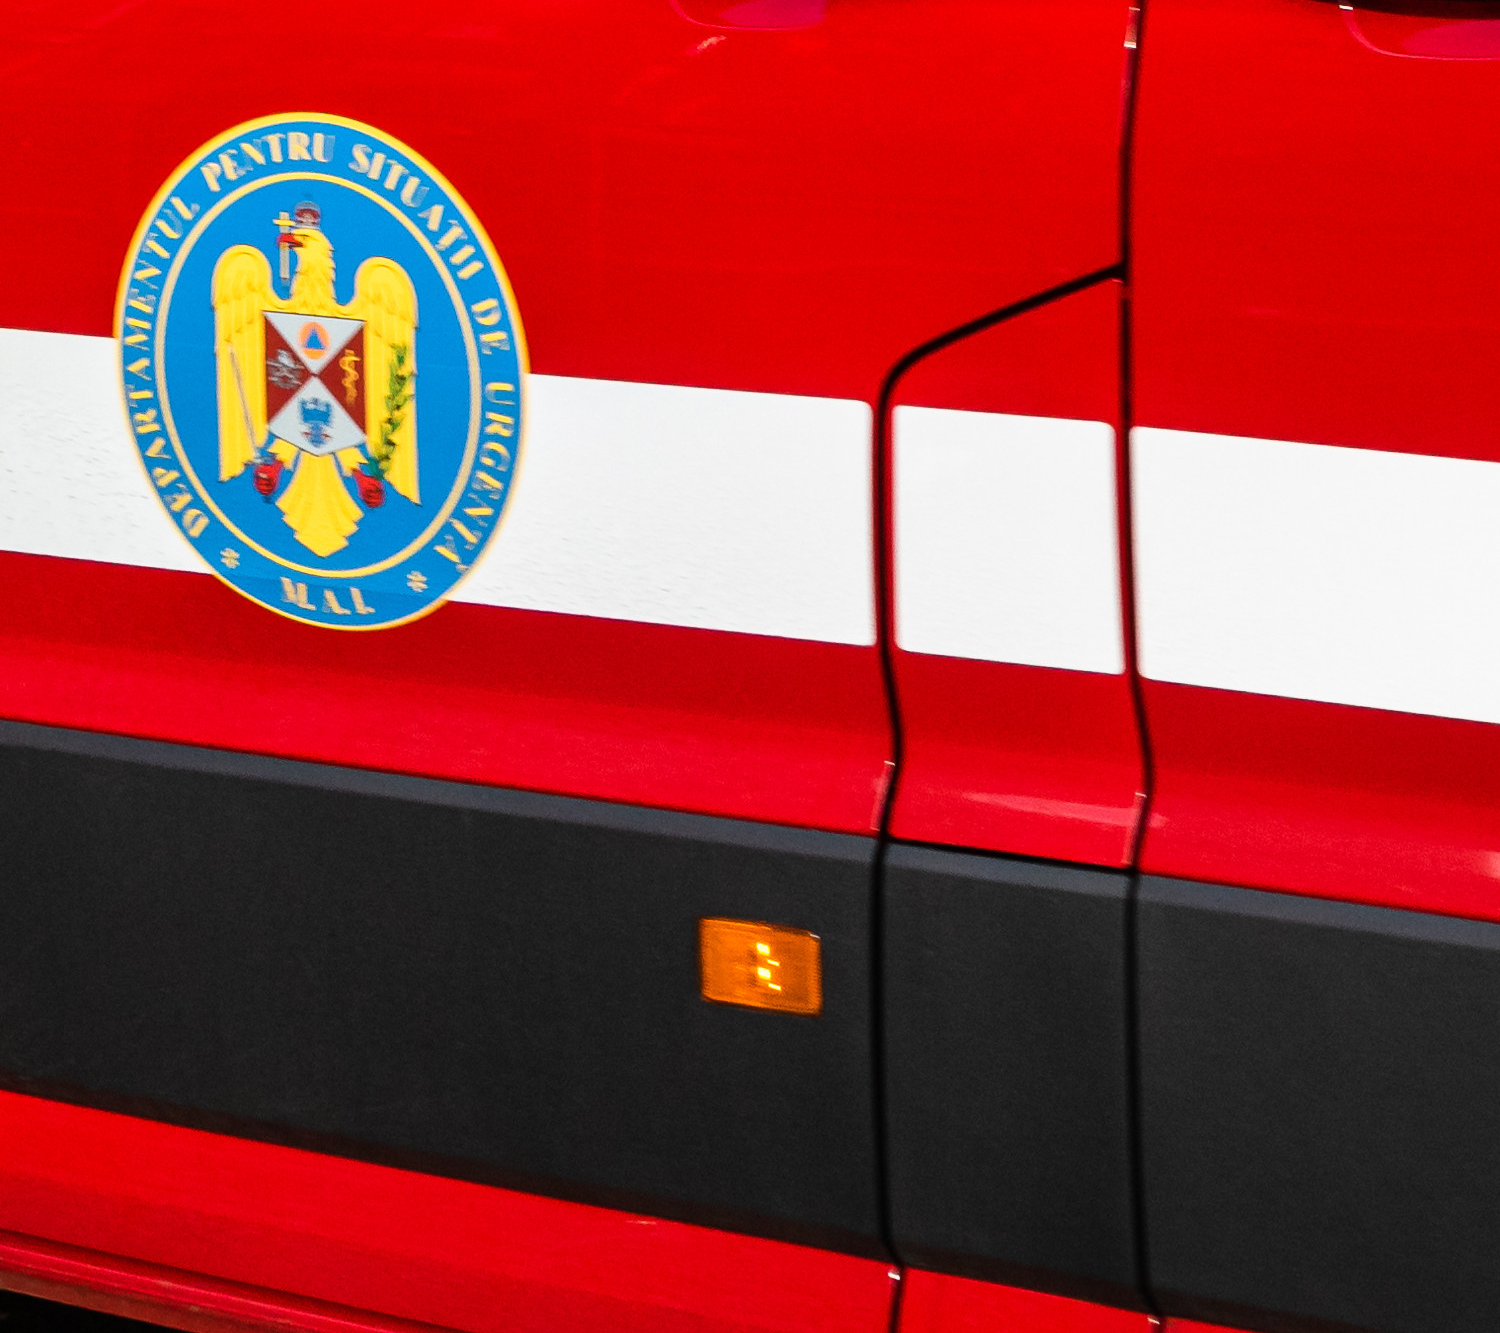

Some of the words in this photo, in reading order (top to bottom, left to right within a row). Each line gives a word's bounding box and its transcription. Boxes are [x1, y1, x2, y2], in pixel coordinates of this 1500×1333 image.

[122, 196, 209, 538] DEPARTAMENTUL
[201, 132, 335, 192] PENTRU
[472, 298, 511, 356] DE
